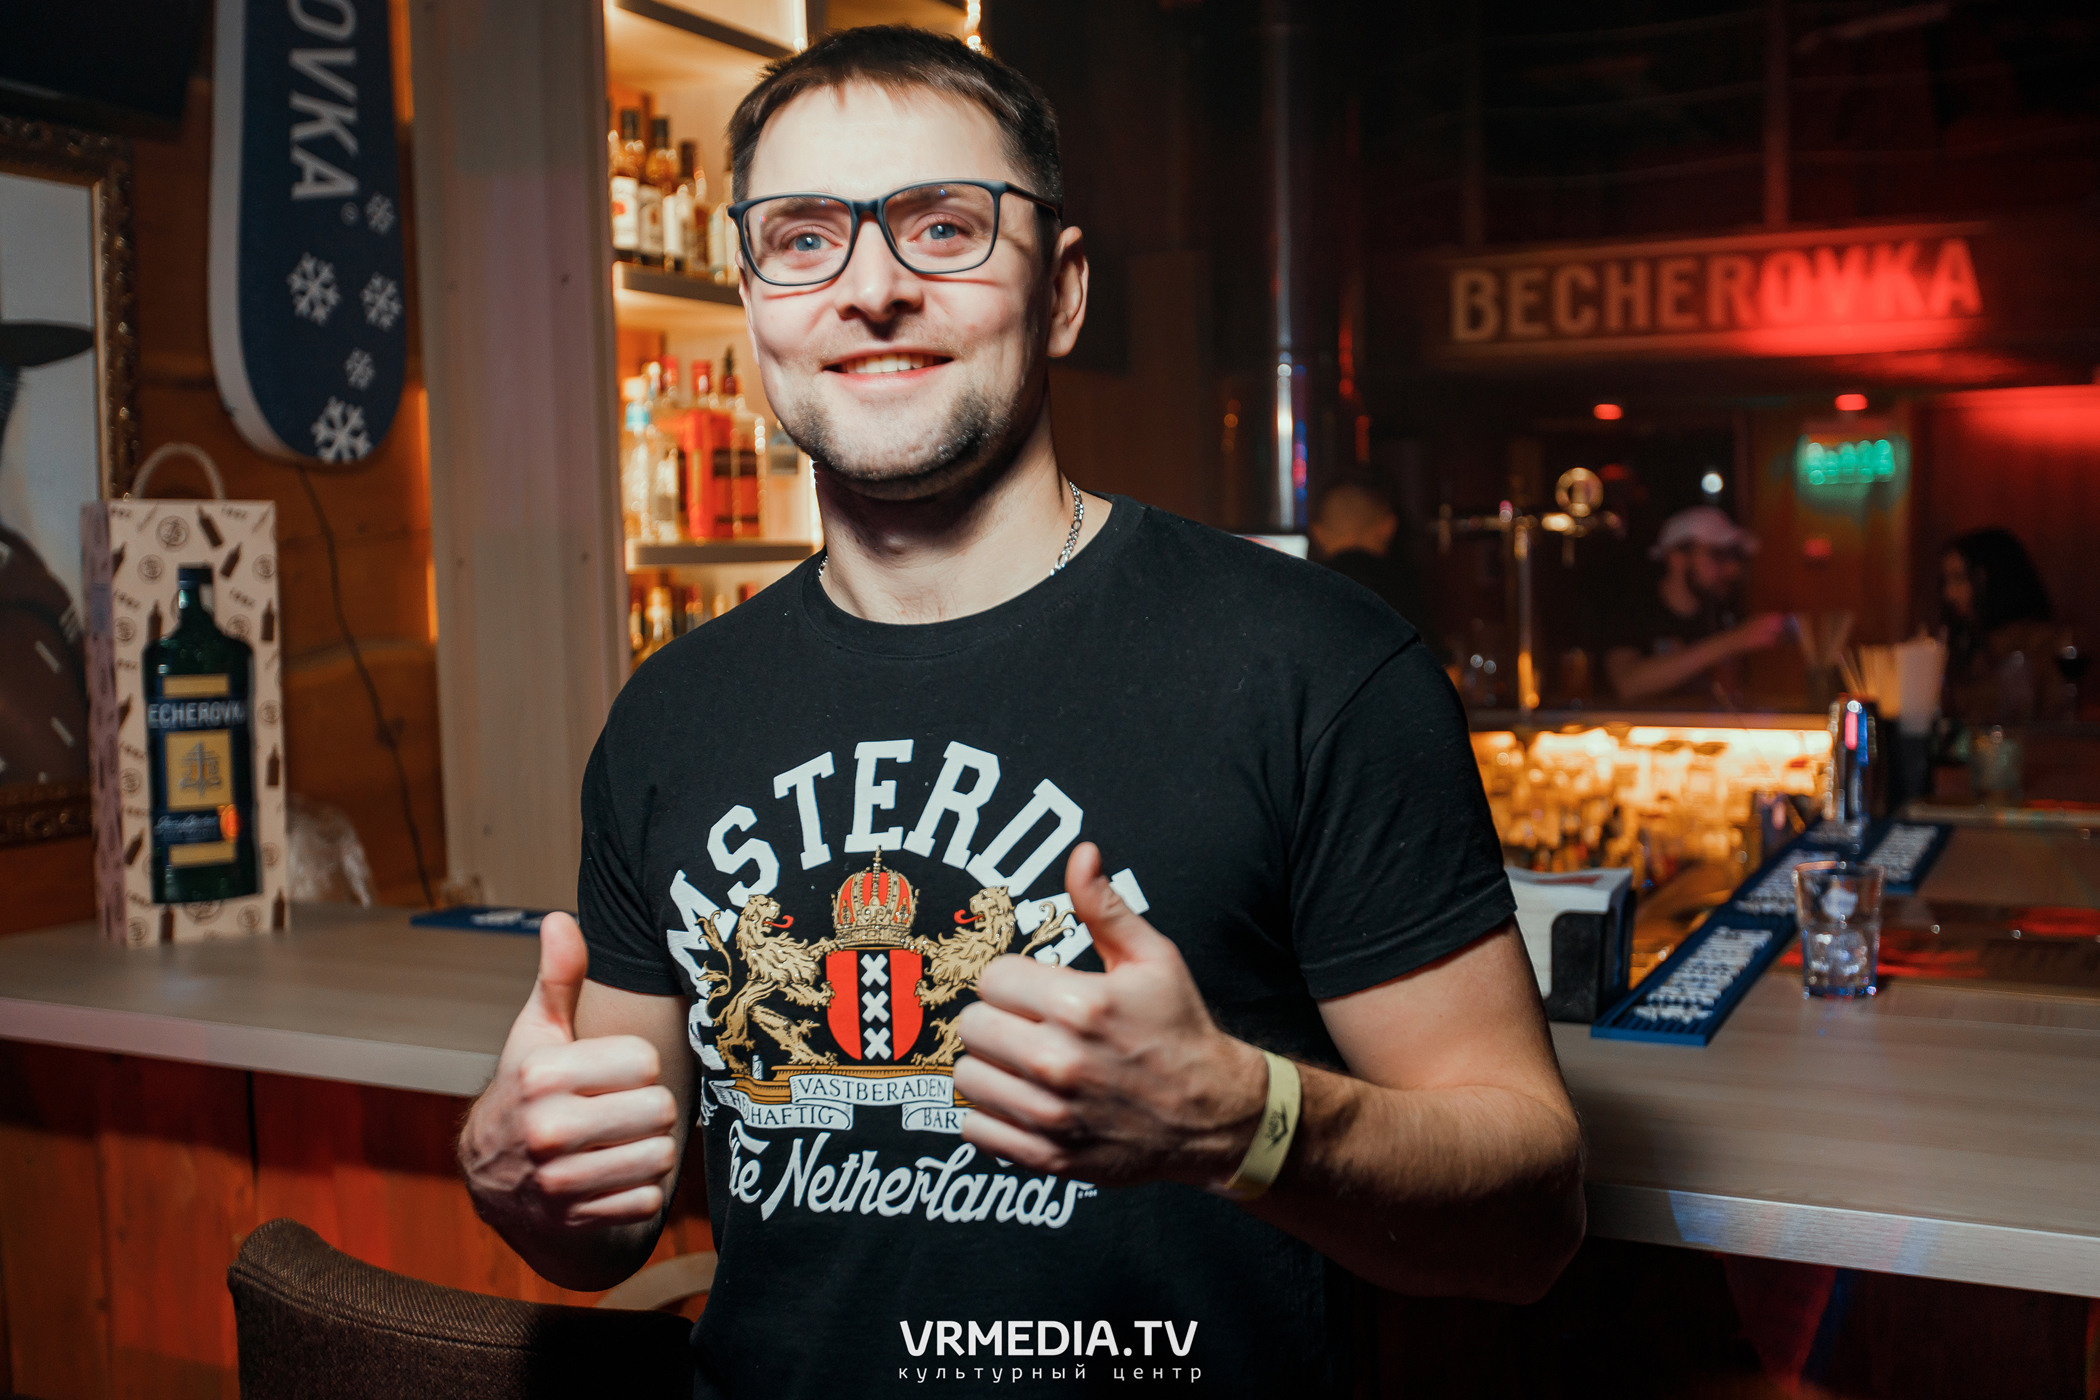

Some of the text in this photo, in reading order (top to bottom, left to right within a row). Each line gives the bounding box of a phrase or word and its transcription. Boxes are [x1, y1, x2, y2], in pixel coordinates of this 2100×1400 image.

[1452, 238, 1982, 342] BECHEROVKA
[798, 1078, 948, 1101] VASTBERADEN
[923, 1107, 967, 1129] BAR
[761, 1132, 1095, 1229] Netherlands
